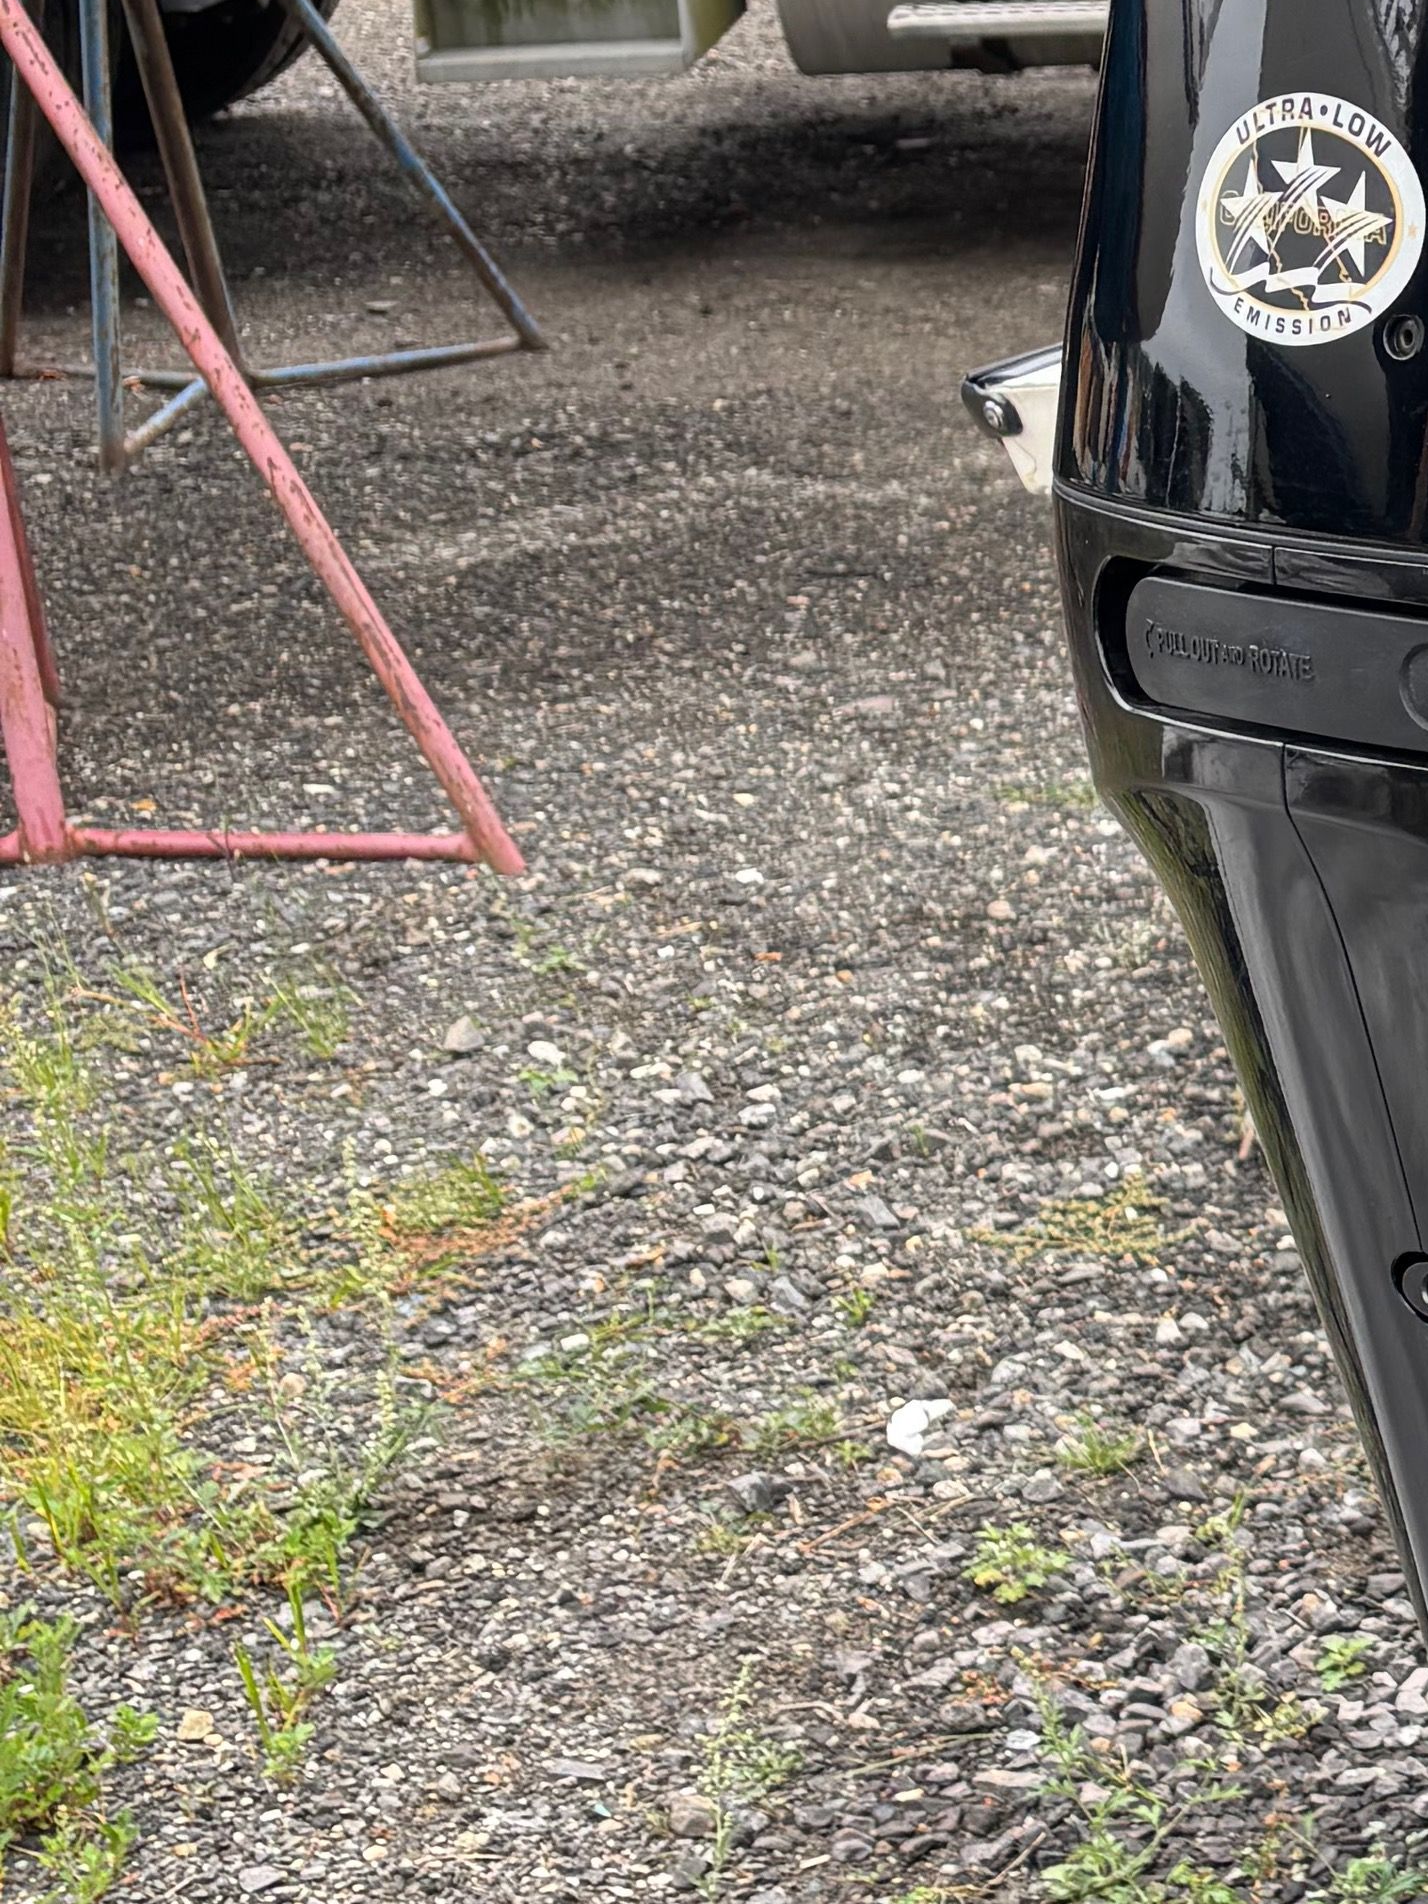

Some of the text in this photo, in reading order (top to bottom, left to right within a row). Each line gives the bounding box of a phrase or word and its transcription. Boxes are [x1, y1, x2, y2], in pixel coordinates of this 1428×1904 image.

[1234, 296, 1352, 335] EMISSION
[1156, 627, 1191, 658] PULL
[1190, 635, 1221, 665] OUT
[1248, 644, 1316, 681] ROTATE
